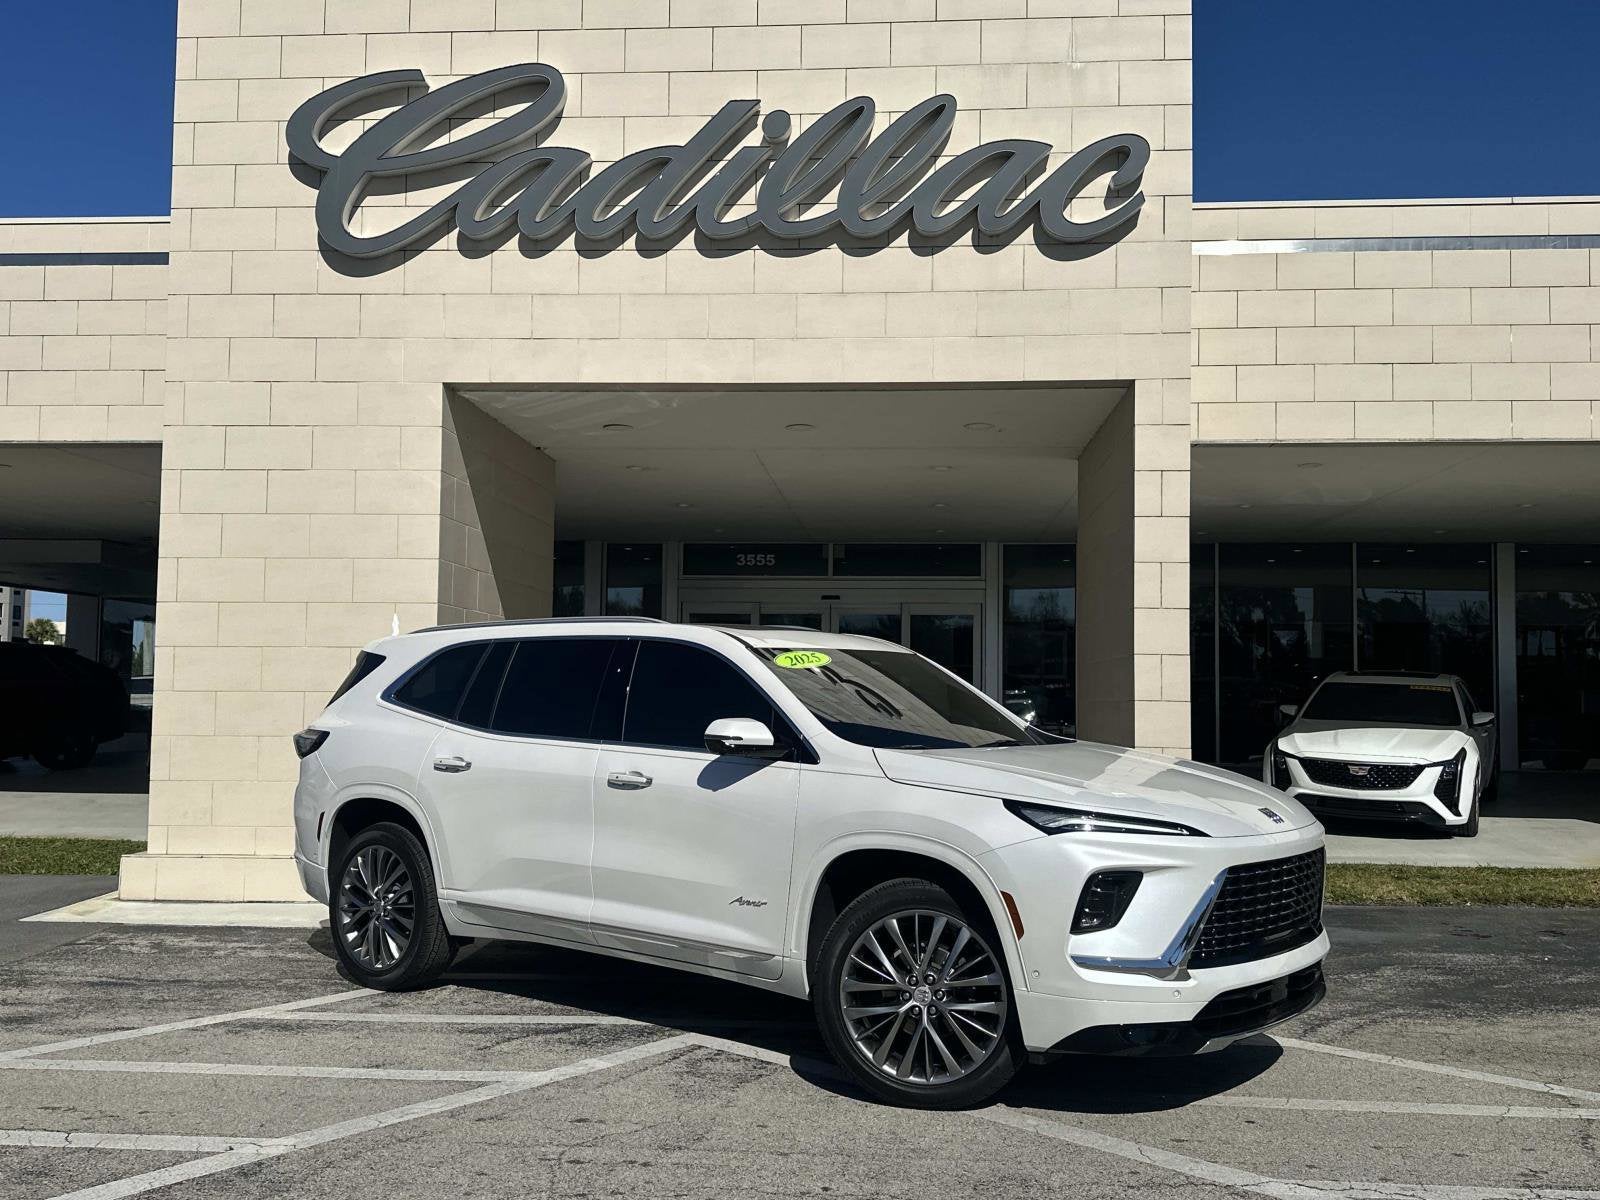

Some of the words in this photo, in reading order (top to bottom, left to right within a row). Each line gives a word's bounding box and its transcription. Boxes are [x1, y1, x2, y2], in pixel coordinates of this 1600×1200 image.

[285, 62, 1151, 259] Cadillac
[736, 553, 776, 566] 3555
[784, 652, 822, 666] 2025
